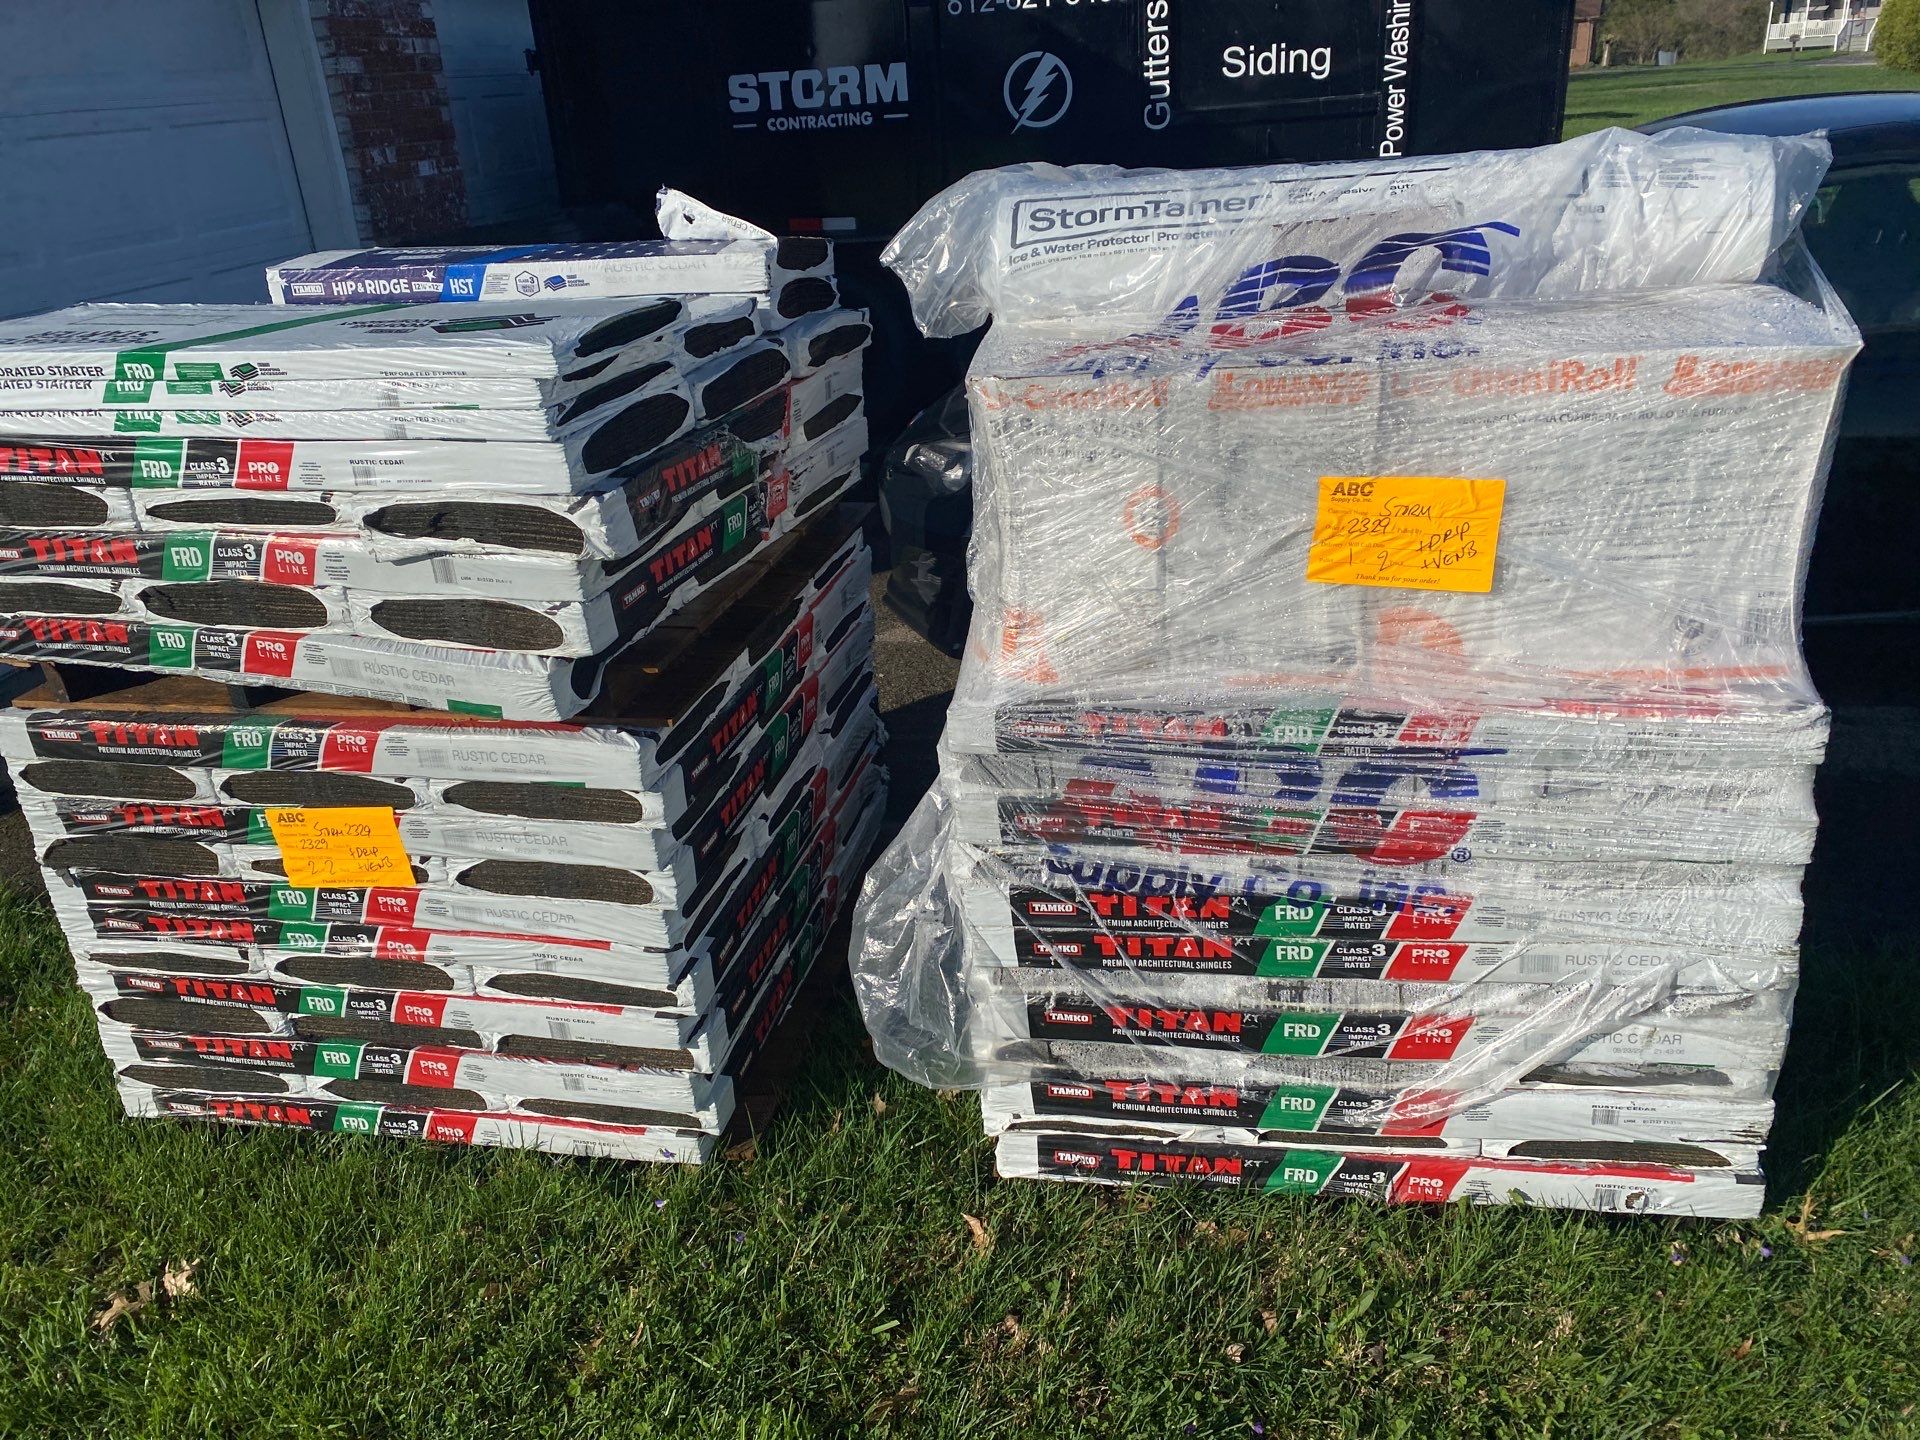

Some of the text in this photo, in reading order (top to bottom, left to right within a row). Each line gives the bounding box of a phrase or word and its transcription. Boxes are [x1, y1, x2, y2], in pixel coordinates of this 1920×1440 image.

[1143, 0, 1170, 130] Gutters
[1222, 42, 1332, 80] Siding
[728, 61, 909, 113] STORM
[766, 111, 873, 132] CONTRACTING
[1379, 84, 1406, 158] Power
[1009, 252, 1029, 266] Ice
[1030, 247, 1041, 258] &
[1043, 242, 1083, 255] Water
[1088, 233, 1150, 249] Protector
[332, 278, 474, 296] HIP & RIDGE HST
[48, 366, 105, 377] STARTER
[140, 460, 172, 478] FRD
[189, 456, 229, 474] CLASS 3
[248, 462, 279, 474] PRO
[251, 475, 282, 483] LINE
[1331, 482, 1376, 496] ABC
[1347, 517, 1391, 534] 2329
[27, 538, 138, 564] TITAN
[170, 547, 203, 568] FRD
[217, 543, 256, 561] CLASS 3
[275, 549, 305, 565] PRO
[650, 525, 712, 583] TITAN
[37, 563, 141, 575] PREMIUM ARCHITECTURAL SHINGLES
[278, 564, 309, 575] LINE
[1355, 573, 1377, 581] Thank
[1390, 574, 1402, 583] for
[24, 618, 128, 644] TITAN
[156, 631, 186, 649] FRD
[226, 632, 238, 646] 3
[256, 640, 285, 652] PRO
[258, 650, 287, 661] LINE
[363, 661, 456, 687] RUSTIC CEDAR
[44, 722, 200, 747] TAMKO TITAN
[232, 732, 262, 748] FRD
[278, 730, 317, 743] CLASS 3
[336, 734, 367, 746] PRO
[98, 746, 202, 758] PREMIUM SHINGLES
[283, 742, 308, 750] IMPACT
[287, 749, 308, 757] RATED
[338, 745, 368, 753] LINE
[452, 749, 547, 765] RUSTIC CEDAR
[277, 813, 305, 823] ABC
[344, 823, 371, 836] 2329
[300, 838, 328, 849] 2329
[475, 830, 568, 847] RUSTIC CEDAR
[308, 860, 336, 875] 2 2
[98, 885, 131, 896] TAMKO
[138, 880, 246, 903] TITAN
[277, 889, 307, 906] FRD
[321, 888, 360, 902] CLASS 3
[328, 901, 352, 909] IMPACT
[377, 896, 407, 906] PRO
[1032, 894, 1230, 920] TAMKO TITAN
[331, 907, 352, 916] RATED
[379, 905, 409, 914] LINE
[485, 907, 575, 924] RUSTIC CEDAR
[108, 919, 139, 930] TAMKO
[1342, 915, 1373, 923] IMPACT
[1343, 921, 1371, 930] RATED
[1037, 942, 1079, 955] TAMKO
[1093, 935, 1233, 958] TITAN
[1275, 944, 1314, 961] FRD
[1336, 942, 1387, 958] CLASS 3
[1341, 954, 1371, 963] IMPACT
[1411, 948, 1451, 960] PRO
[1412, 957, 1451, 965] LINE
[1102, 959, 1232, 970] PREMIUM ARCHITECTURAL SHINGLES
[1344, 961, 1371, 969] RATED
[129, 978, 276, 1005] TAMKO TITAN
[307, 995, 335, 1012] FRD
[350, 999, 387, 1011] CLASS 3
[405, 1005, 433, 1017] PRO
[407, 1014, 435, 1024] LINE
[545, 1015, 572, 1023] RUSTIC
[1049, 1008, 1242, 1033] TAMKO TITAN
[1283, 1023, 1321, 1039] FRD
[1343, 1022, 1392, 1037] CLASS 3
[1204, 1033, 1241, 1043] SHINGLES
[189, 1037, 293, 1061] TITAN
[322, 1052, 351, 1065] FRD
[419, 1060, 448, 1070] PRO
[421, 1068, 450, 1077] LINE
[560, 1072, 609, 1082] RUSTIC CEDAR
[1050, 1087, 1091, 1098] TAMKO
[1112, 1102, 1238, 1118] PREMIUM ARCHITECTURAL SHINGLES
[1280, 1096, 1317, 1112] FRD
[1110, 1148, 1242, 1174] TITAN
[1283, 1168, 1319, 1184] FRD
[1339, 1173, 1371, 1184] CLASS
